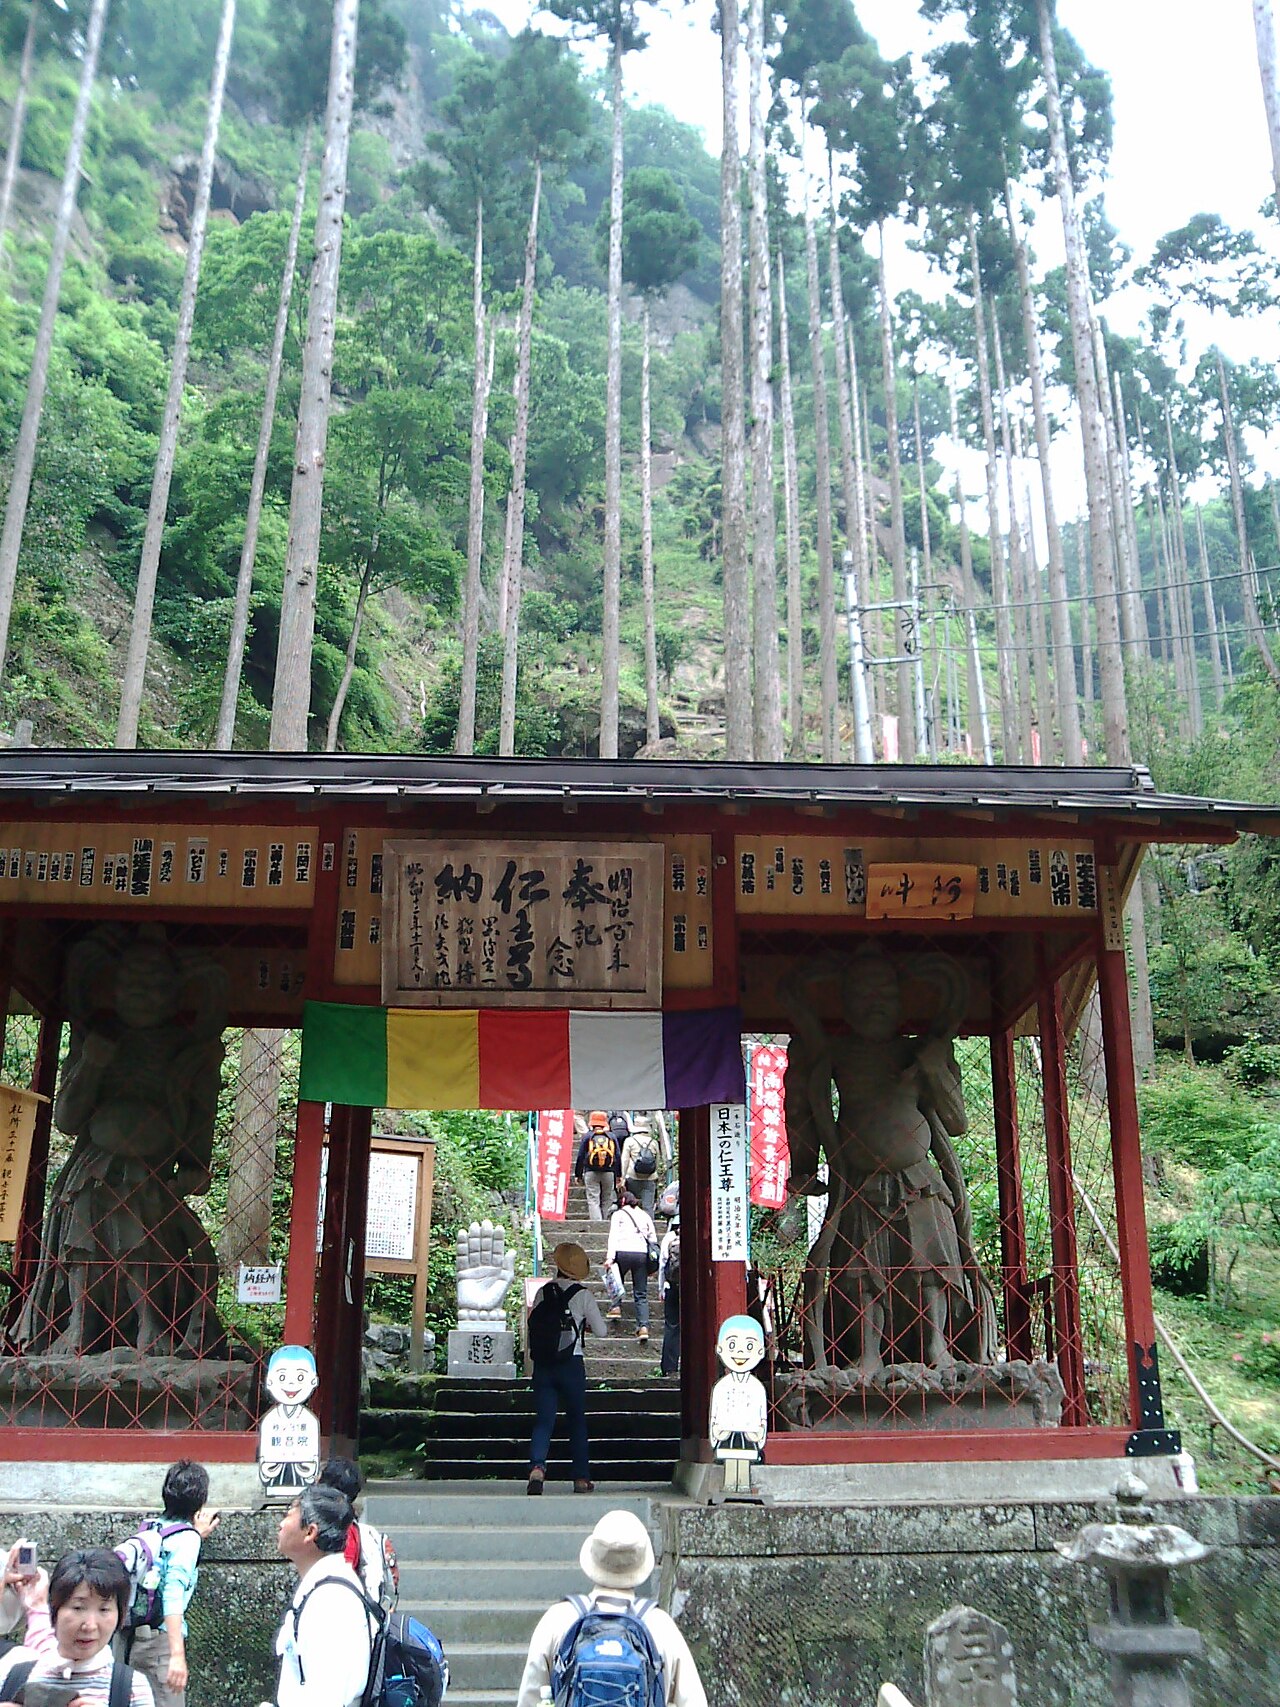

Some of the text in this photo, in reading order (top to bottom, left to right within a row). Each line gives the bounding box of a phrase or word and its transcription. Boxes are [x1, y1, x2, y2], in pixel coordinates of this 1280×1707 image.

[717, 1107, 735, 1192] 日本一の仁王尊
